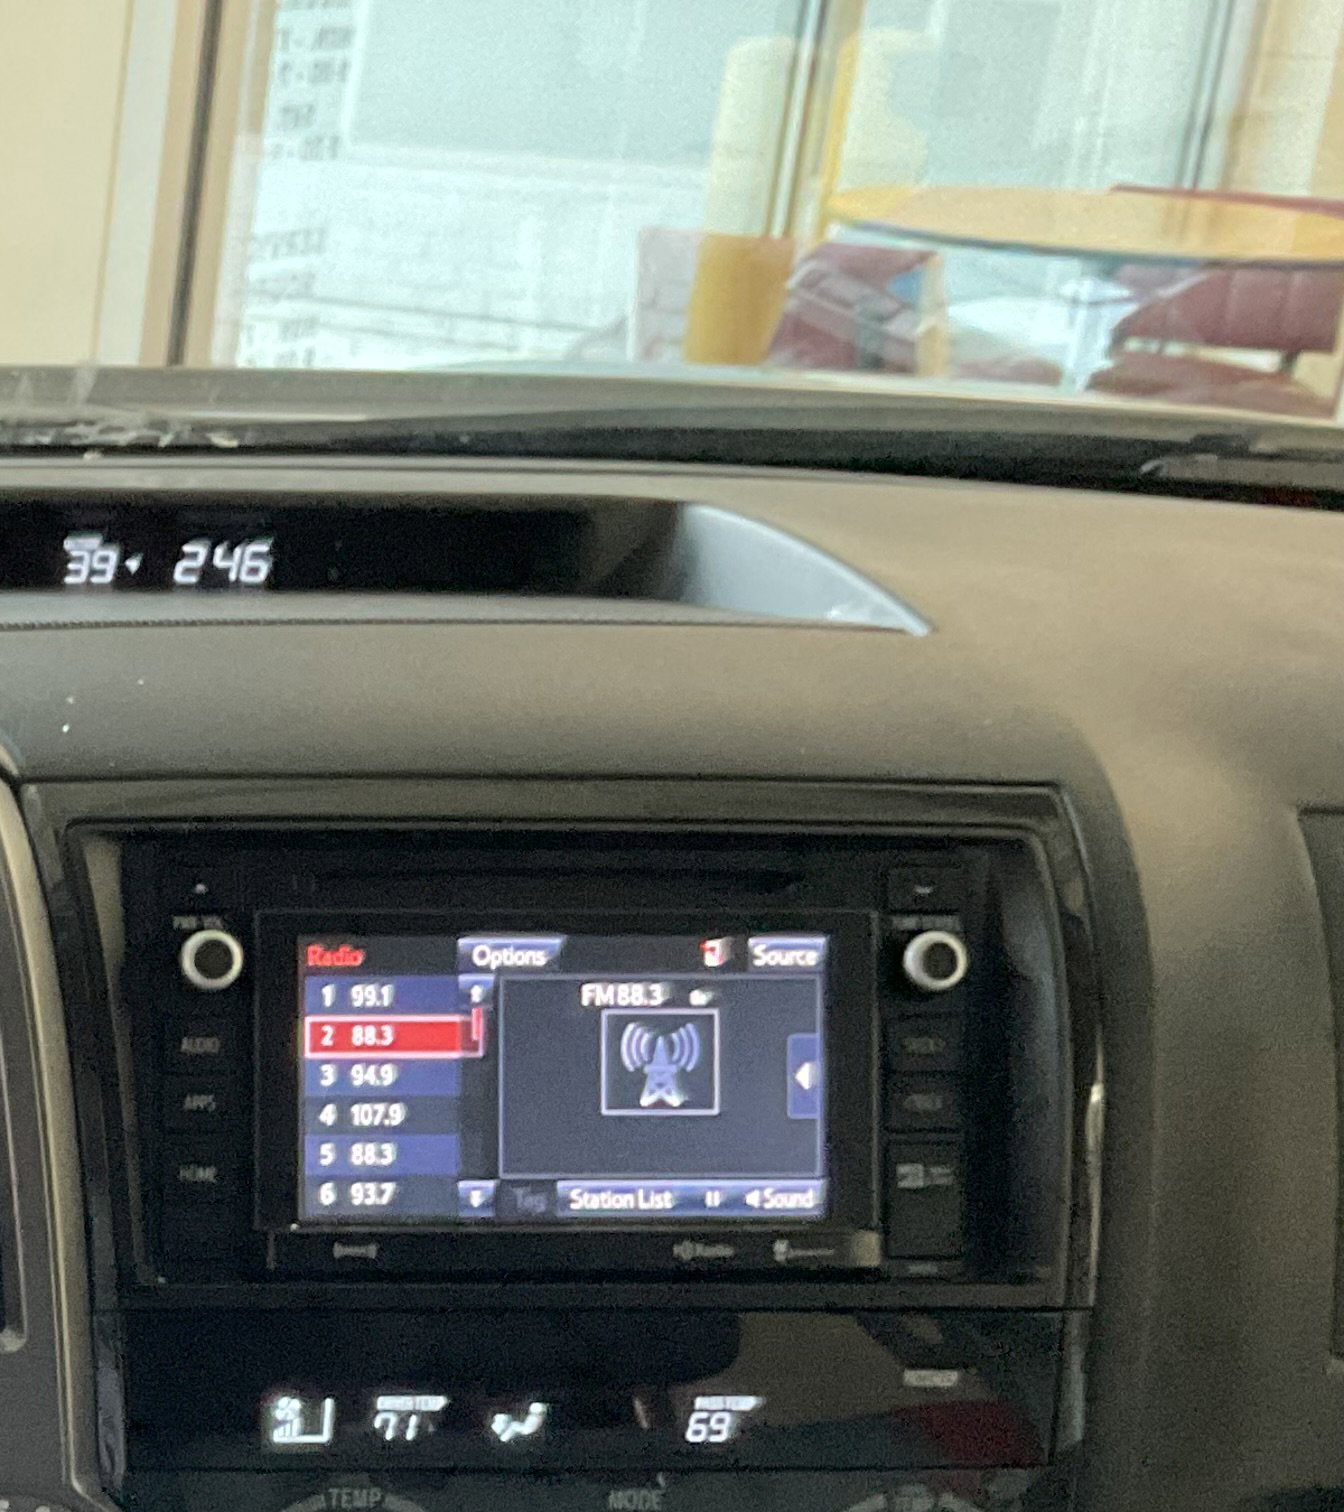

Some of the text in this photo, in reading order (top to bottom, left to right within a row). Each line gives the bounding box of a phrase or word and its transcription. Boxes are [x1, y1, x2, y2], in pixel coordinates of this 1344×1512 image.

[63, 551, 120, 584] 39
[306, 944, 365, 966] Radio
[472, 945, 548, 970] Options
[753, 944, 817, 966] Source
[321, 984, 394, 1007] 1 99.1
[320, 1026, 394, 1046] 2 88.3
[319, 1064, 397, 1086] 3 94.9
[319, 1104, 406, 1125] 4 107.9
[319, 1143, 396, 1165] 5 88.3
[319, 1182, 395, 1205] 6 93.7
[570, 1189, 673, 1209] Station List
[764, 1188, 814, 1209] Sound
[685, 1411, 732, 1442] 69
[328, 1488, 382, 1510] TEMP
[609, 1489, 662, 1511] MODE
